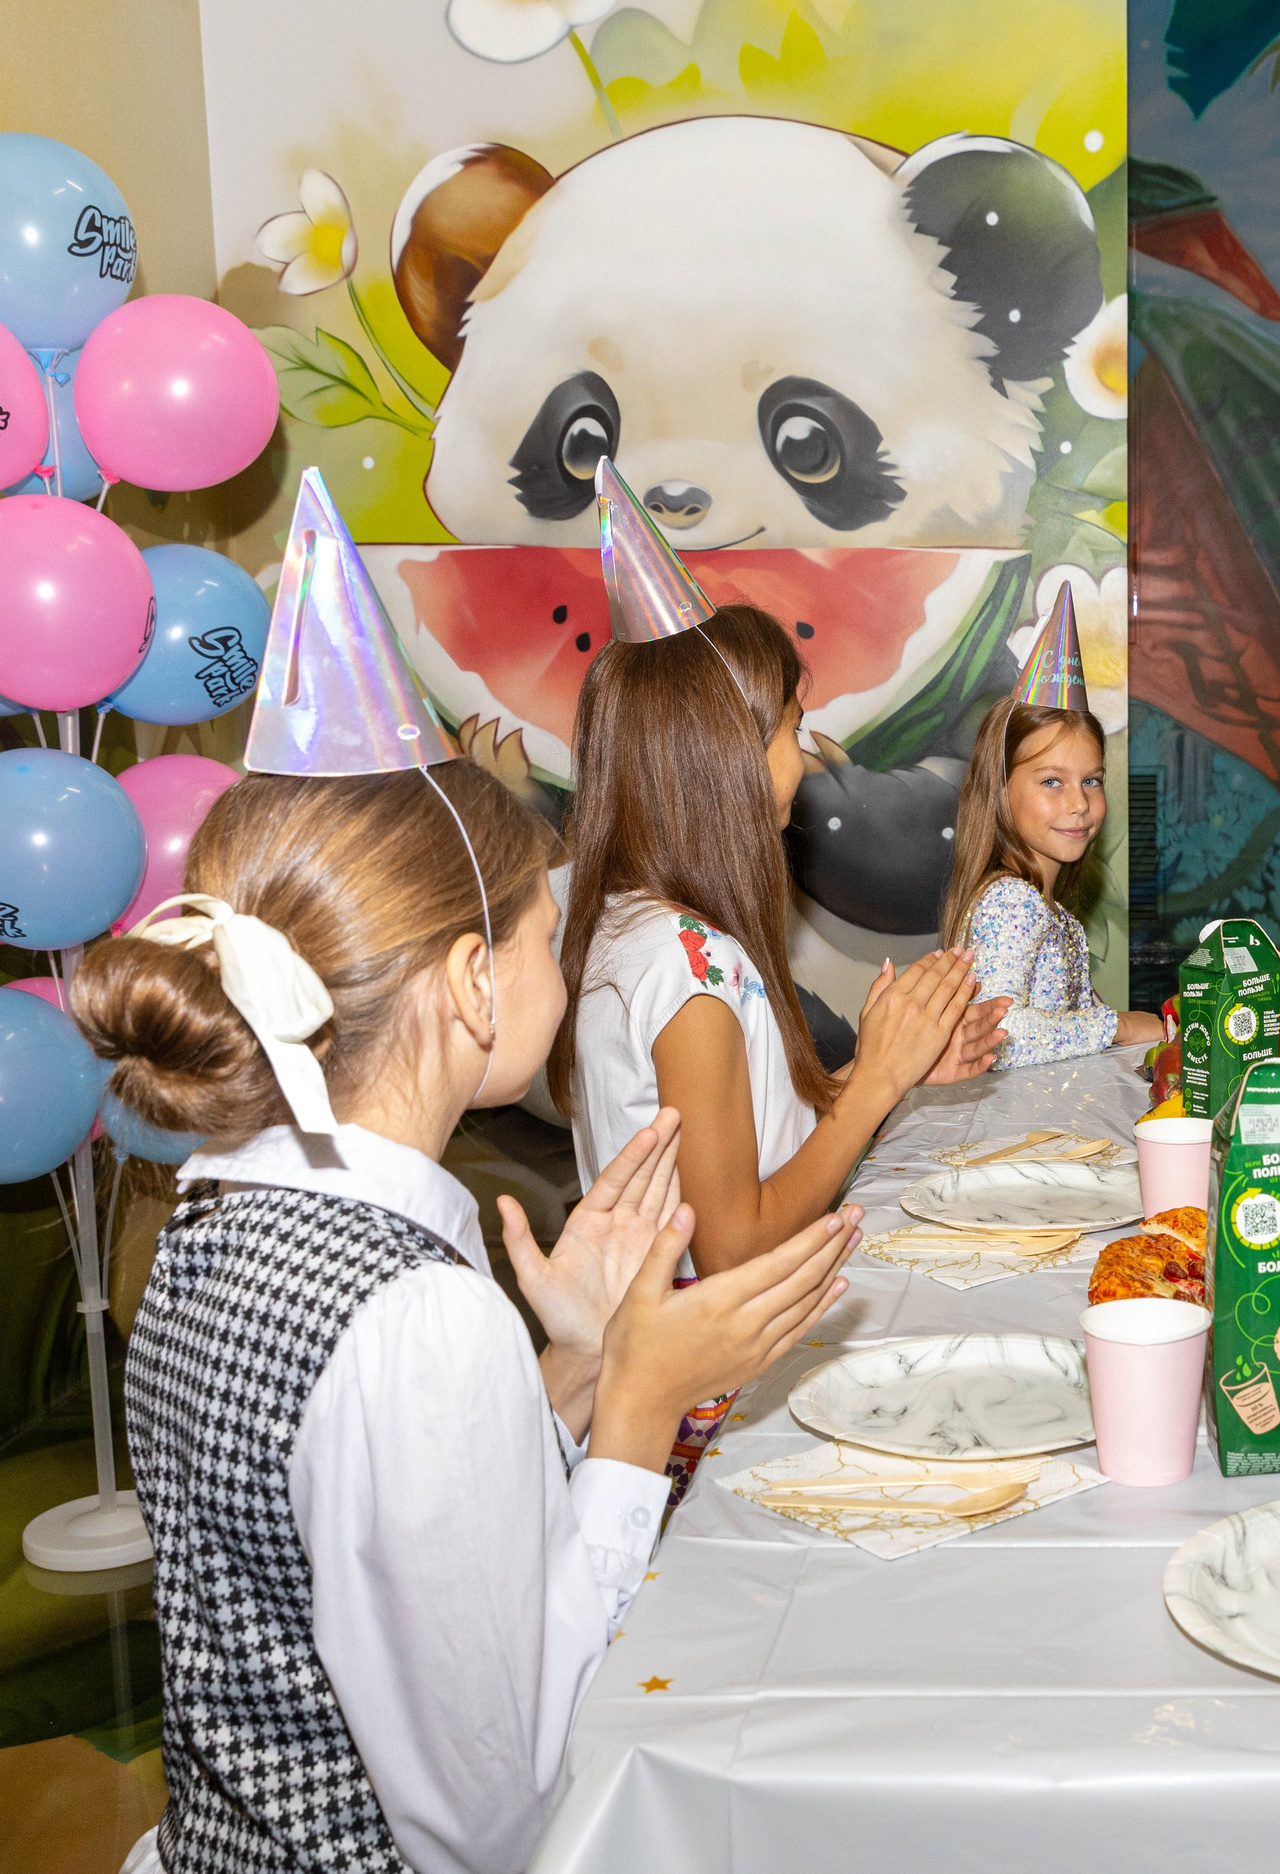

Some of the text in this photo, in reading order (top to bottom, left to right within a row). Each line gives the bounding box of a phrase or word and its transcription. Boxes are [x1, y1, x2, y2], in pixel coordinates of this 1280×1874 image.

[188, 626, 258, 694] Smile
[1059, 651, 1081, 671] днё
[1187, 982, 1210, 990] БОЛЬШЕ
[1242, 973, 1271, 987] БОЛЬШЕ
[1238, 984, 1264, 997] ПОЛЬЗЫ
[1242, 1047, 1273, 1061] БОЛЬШЕ
